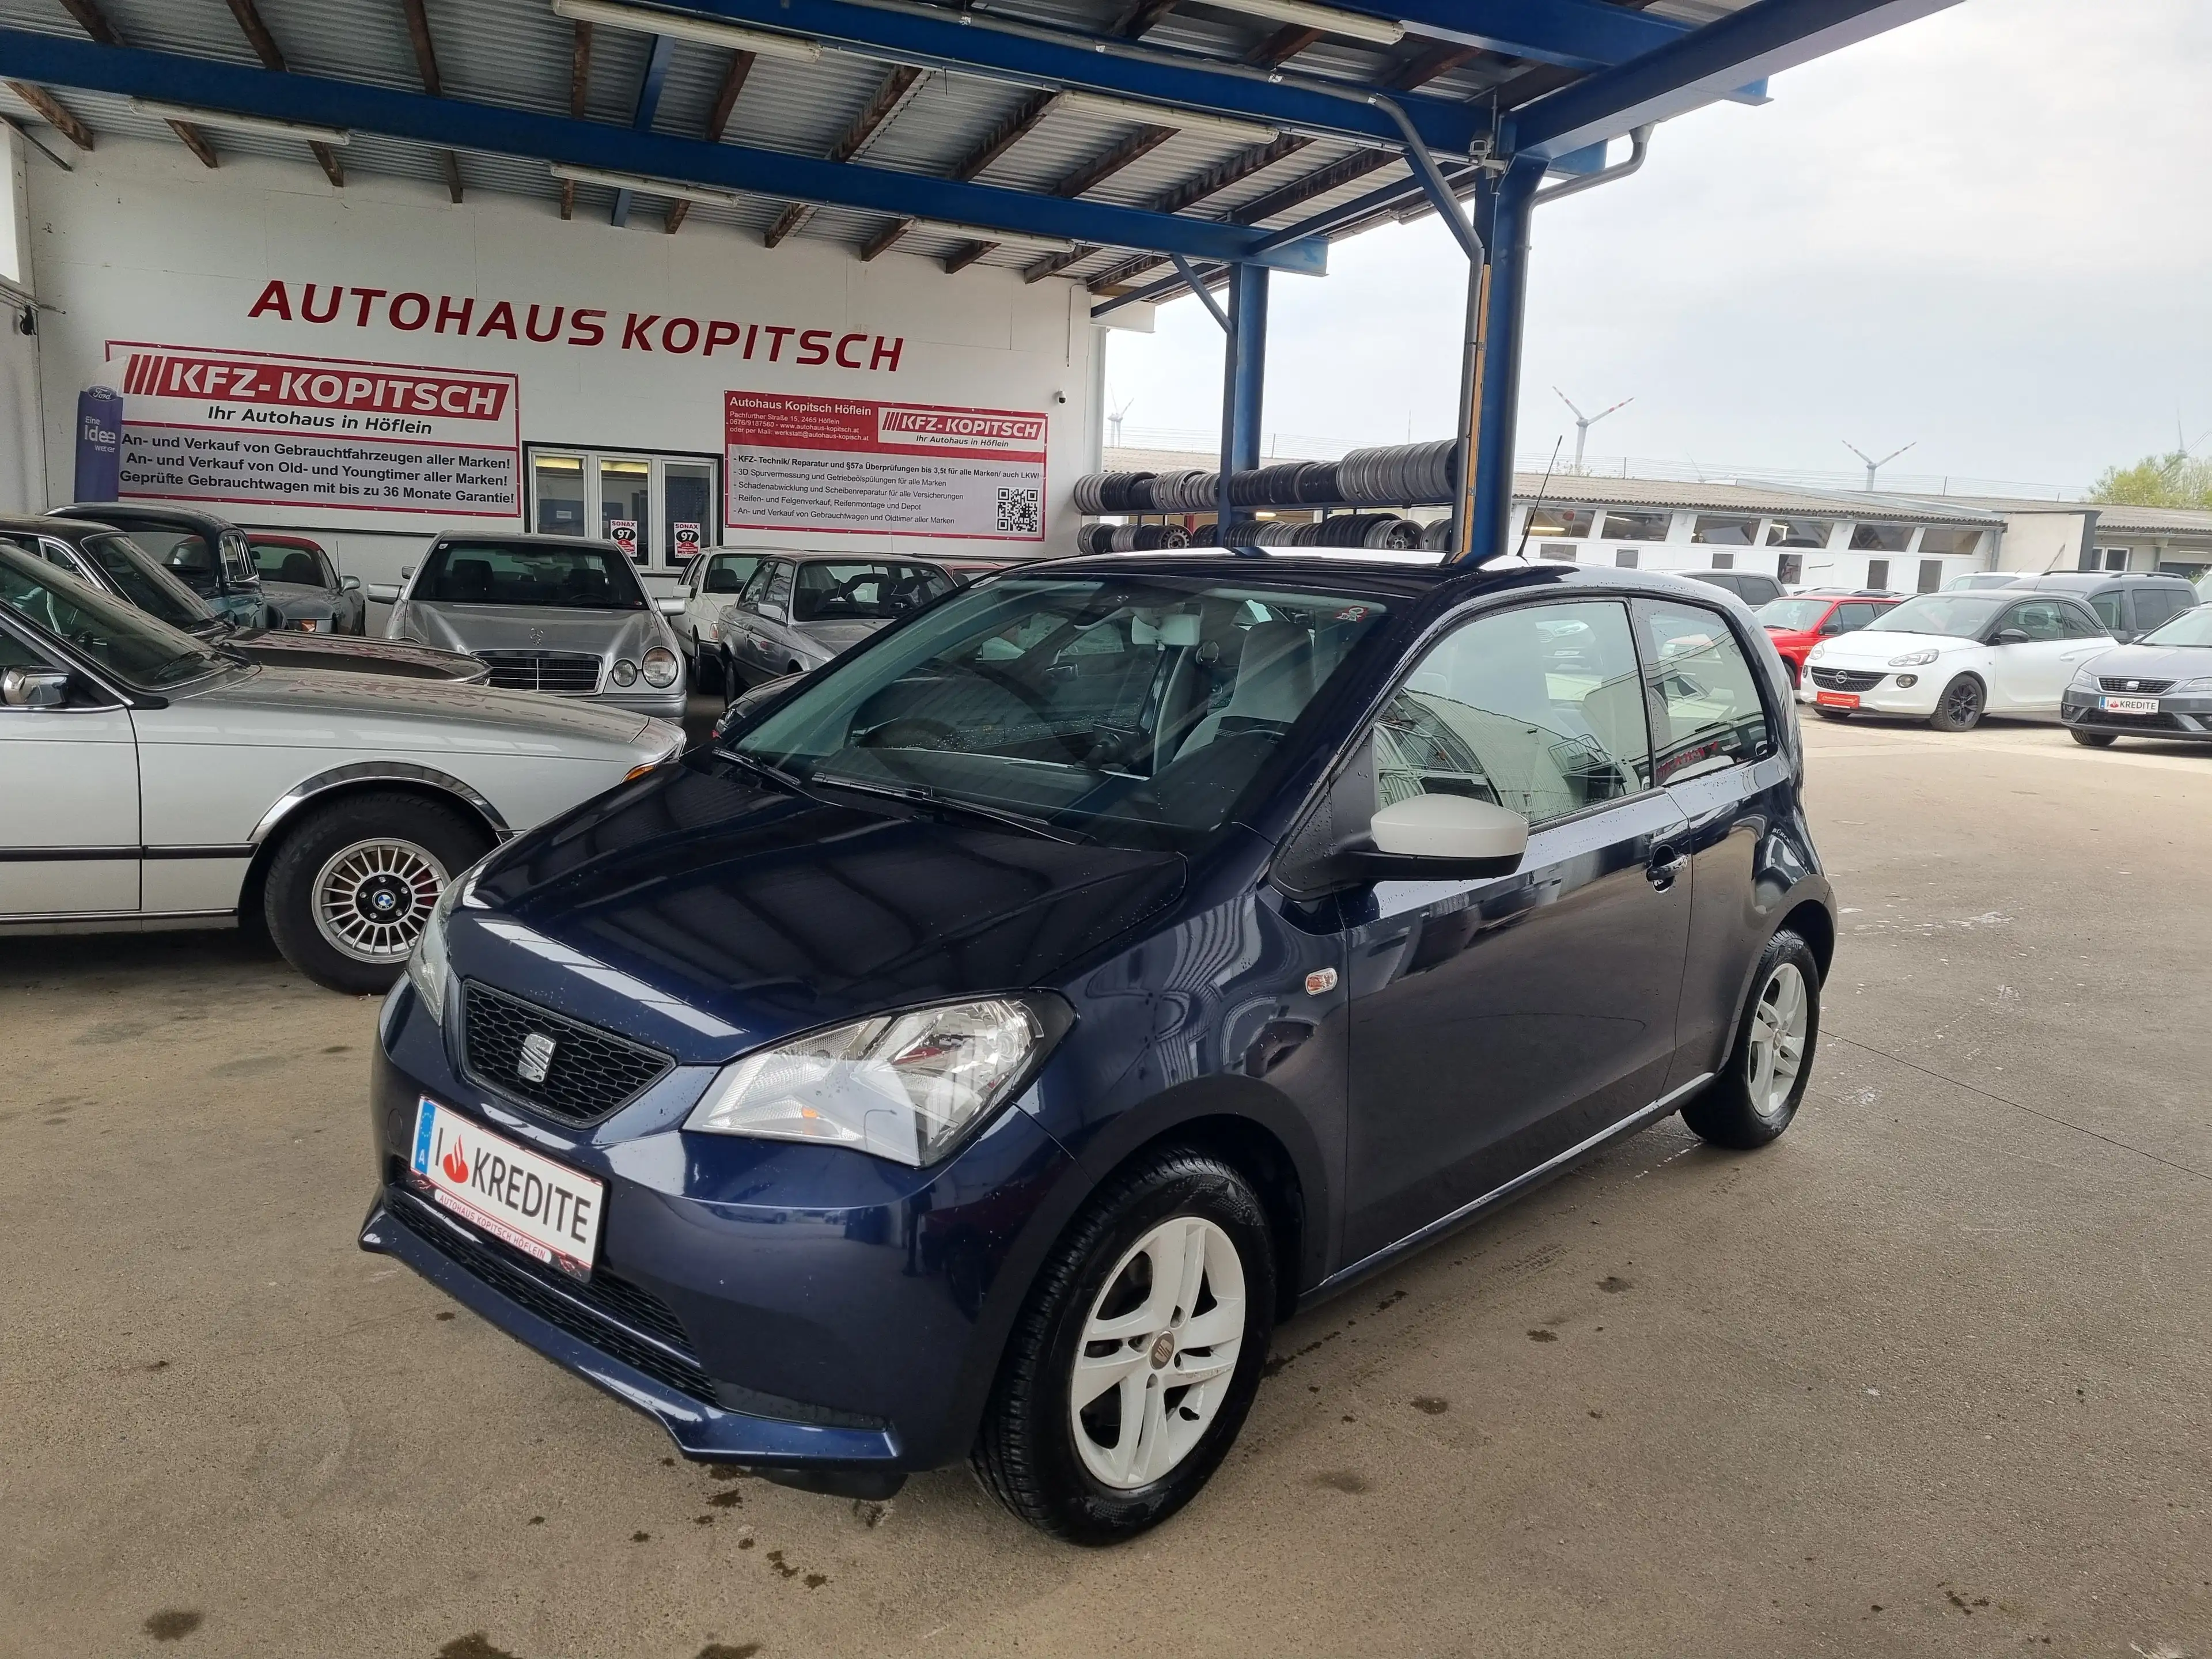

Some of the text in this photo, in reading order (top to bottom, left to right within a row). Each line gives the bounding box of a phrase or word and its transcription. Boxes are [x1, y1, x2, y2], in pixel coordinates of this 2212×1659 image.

[248, 280, 903, 372] AUTOHAUS KOPITSCH
[93, 388, 112, 400] Ford
[729, 396, 872, 416] Autohaus Kopitsch Höflein
[85, 416, 101, 425] Eine
[208, 406, 432, 434] Ihr Autohaus in Höflein
[729, 419, 859, 434] 0676/9187560 www.autohaus-kopitsch.at
[930, 435, 968, 445] Autohaus
[980, 439, 1009, 447] Höflein
[122, 433, 510, 469] An- und Verkauf von Gebrauchtfahrzeugen aller Marken!
[126, 452, 507, 486] An- und Verkauf von Old- und Youngtimer aller Marken!
[738, 455, 757, 463] KFZ-
[758, 456, 790, 465] Technik/
[792, 459, 828, 468] Reparatur
[846, 462, 863, 470] §57a
[865, 461, 919, 473] Überprüfungen
[934, 467, 946, 475] 3,5t
[974, 469, 1001, 478] Marken/
[751, 469, 809, 480] Spurvermessung
[827, 474, 896, 485] Getriebeölspülungen
[120, 470, 514, 503] Geprüfte Gebrauchtwagen mit bis zu 36 Monate Garantie!
[738, 481, 808, 493] Schadenabwicklung
[825, 486, 887, 496] Scheibenreparatur
[913, 491, 964, 501] Versicherungen
[738, 494, 764, 502] Reifen-
[781, 497, 832, 506] Felgenverkauf,
[834, 499, 885, 509] Reifenmontage
[767, 509, 795, 517] Verkauf
[810, 511, 869, 521] Gebrauchtwagen
[885, 514, 913, 522] Oldtimer
[618, 529, 631, 539] 97
[681, 532, 694, 541] 97
[2120, 700, 2157, 710] KREDITE
[418, 1149, 426, 1165] A
[435, 1127, 592, 1244] I KREDITE
[439, 1194, 546, 1259] AUTOHAUS KOPITSCH HÖFLEIN
